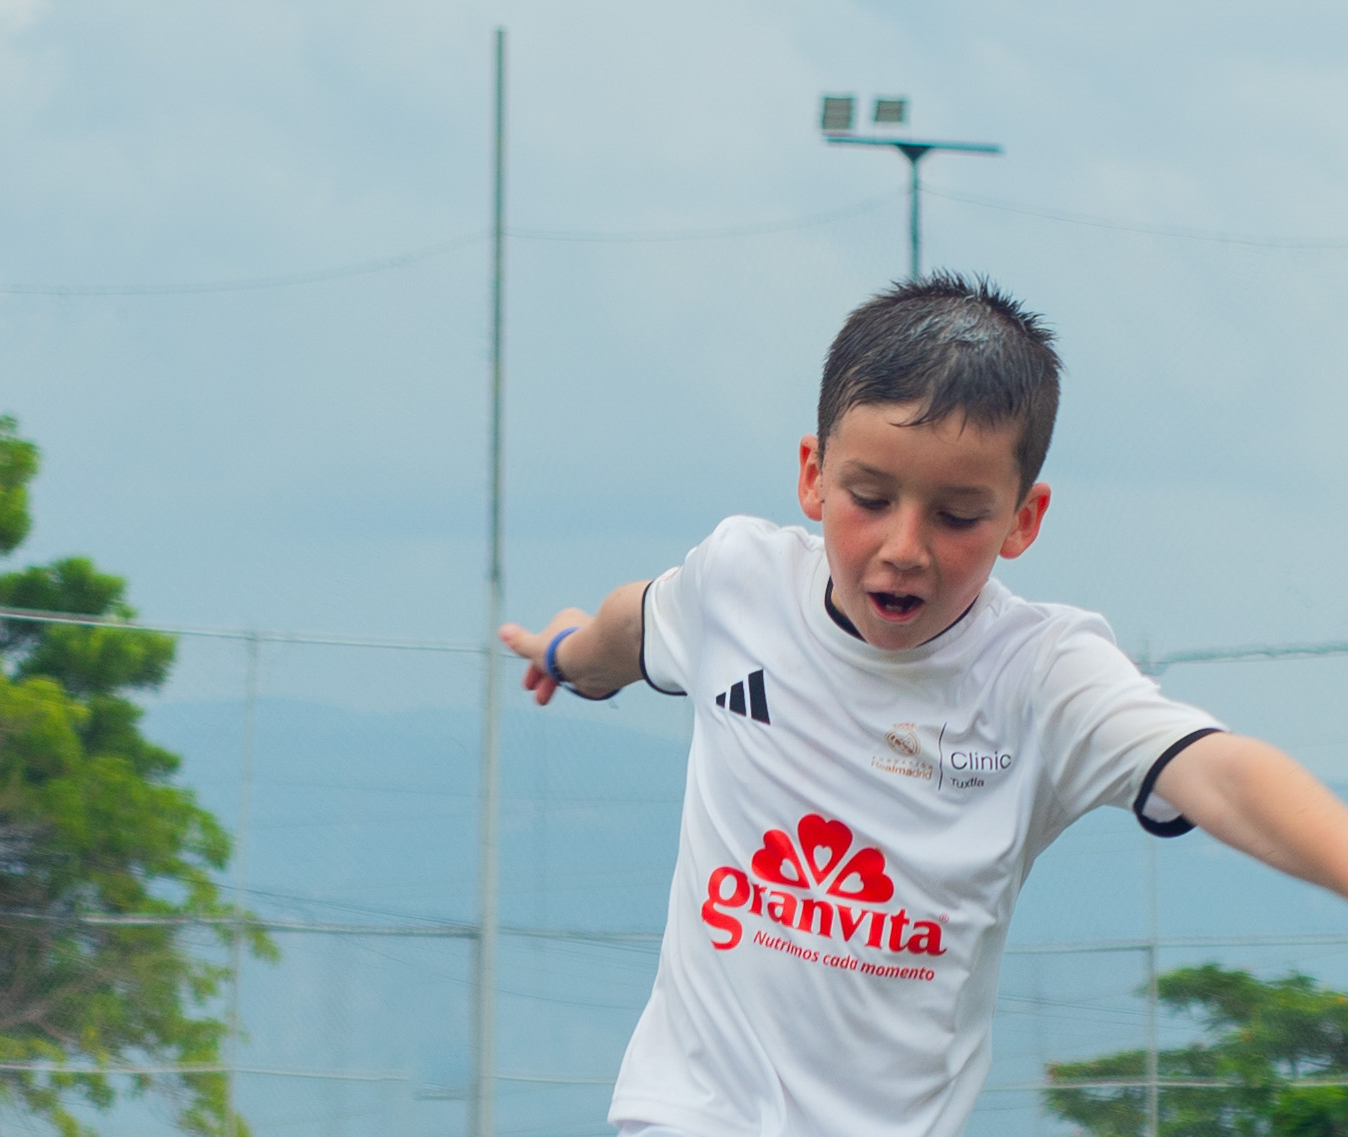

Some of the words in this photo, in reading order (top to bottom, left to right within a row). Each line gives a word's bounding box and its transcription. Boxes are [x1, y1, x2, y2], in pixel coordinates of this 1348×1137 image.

[950, 751, 1012, 770] Clinic
[950, 777, 984, 789] Tuxtla
[701, 866, 948, 957] granvita
[753, 930, 818, 962] Nutrimos
[823, 955, 858, 970] cada
[860, 960, 935, 982] momento
